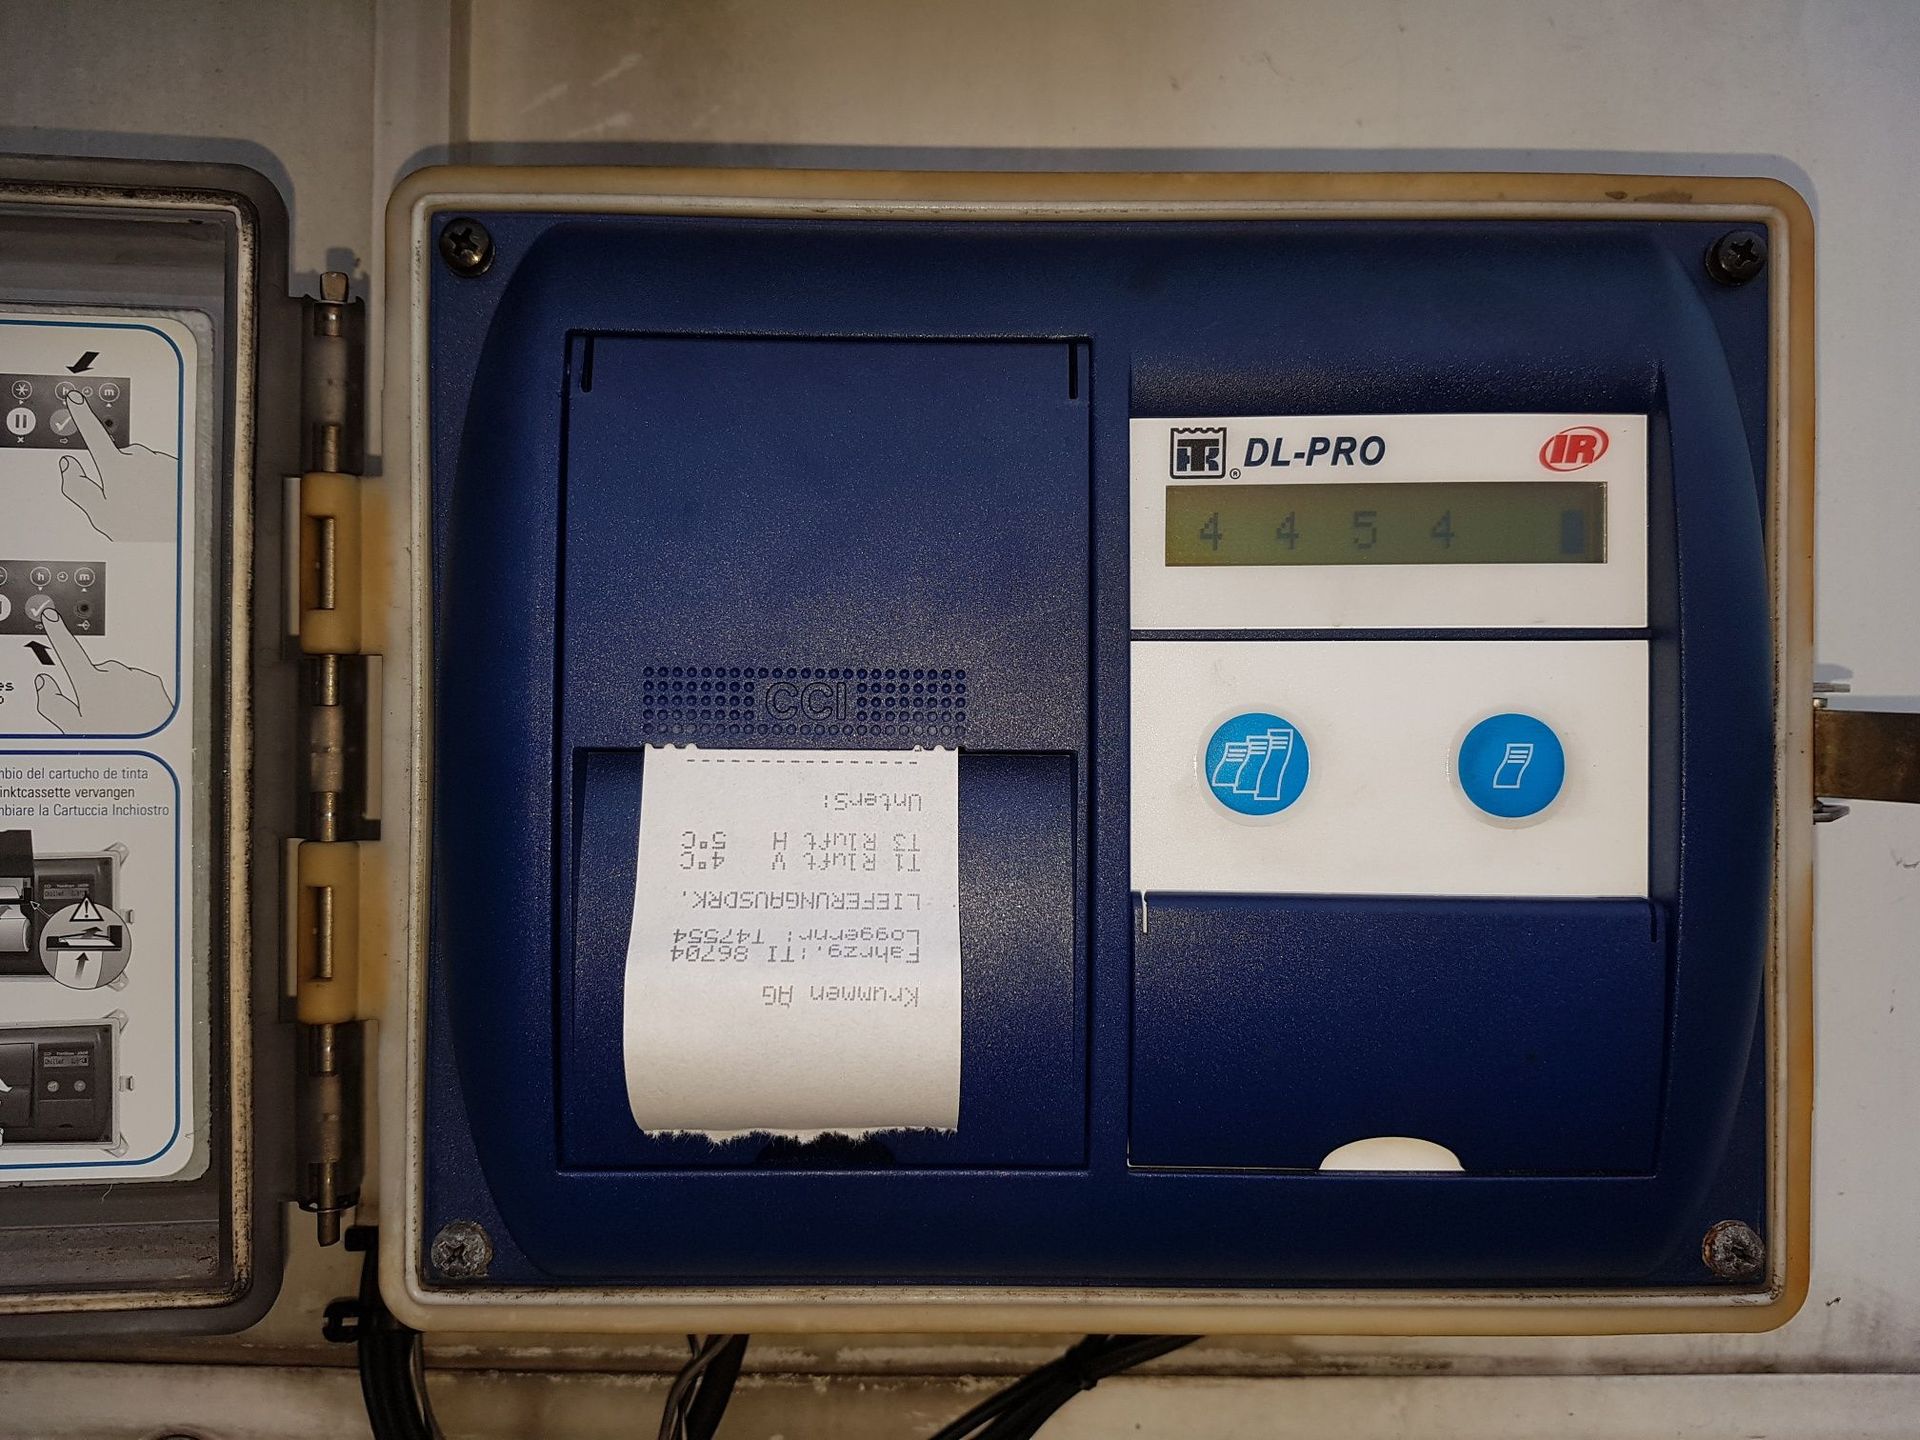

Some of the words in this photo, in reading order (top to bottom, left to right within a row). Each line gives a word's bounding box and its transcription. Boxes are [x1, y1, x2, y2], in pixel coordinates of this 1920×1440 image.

[1244, 435, 1386, 467] DL-PRO
[1549, 435, 1598, 463] IR
[1199, 511, 1223, 551] 4
[1276, 511, 1300, 550] 4
[1353, 511, 1377, 550] 5
[1430, 511, 1455, 549] 4
[38, 572, 44, 580] h
[765, 681, 847, 721] CCI
[27, 768, 45, 779] del
[49, 768, 99, 779] cartucho
[103, 768, 117, 779] de
[122, 768, 148, 779] tinta
[75, 789, 135, 800] vervangen
[39, 804, 49, 816] la
[54, 804, 107, 816] Cartuccia
[113, 804, 169, 816] Inchiostro
[682, 831, 727, 850] 5°C
[773, 832, 787, 850] H
[893, 833, 920, 852] T3
[680, 852, 725, 870] 4°C
[772, 853, 786, 870] V
[895, 853, 920, 872] T1
[682, 891, 920, 910] LIEFERUNGAUSDRK.
[673, 929, 764, 944] T47554
[787, 927, 920, 946] Loggernr:
[670, 945, 749, 962] 86704
[763, 985, 794, 1007] AG
[810, 986, 919, 1007] Krummen
